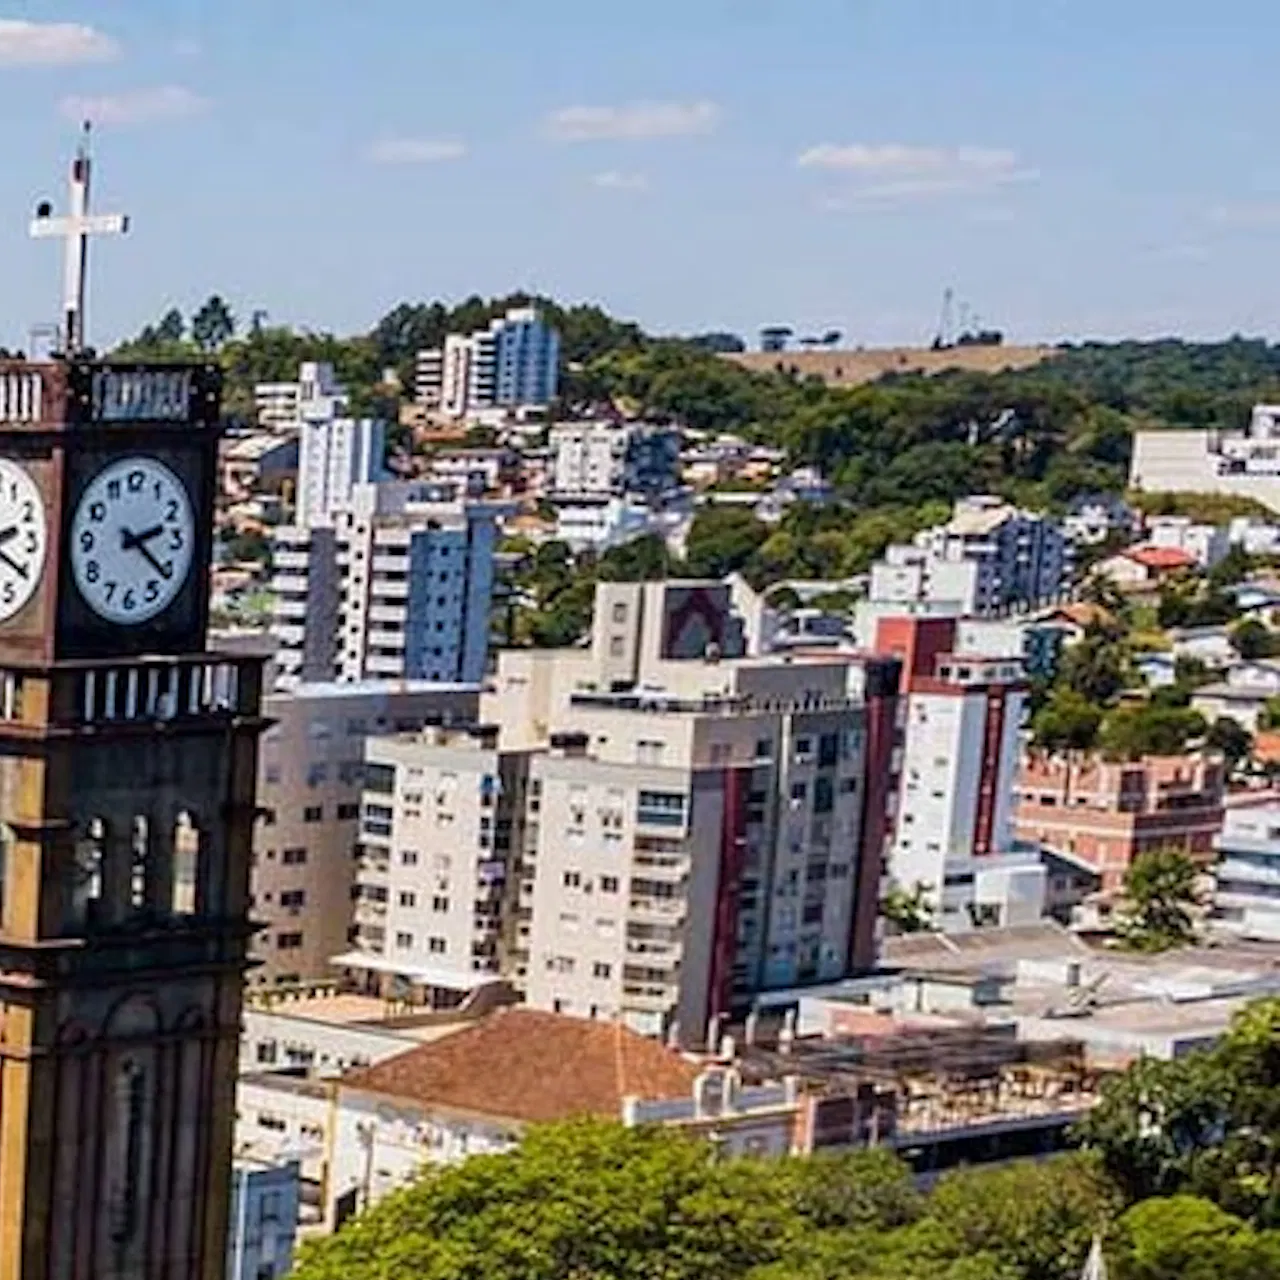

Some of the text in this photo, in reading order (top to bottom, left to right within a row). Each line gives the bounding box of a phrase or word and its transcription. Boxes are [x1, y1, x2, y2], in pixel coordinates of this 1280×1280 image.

[10, 483, 17, 500] 1
[154, 482, 162, 500] 1
[24, 501, 33, 522] 2
[165, 500, 179, 522] 2
[27, 530, 38, 554] 3
[80, 531, 94, 553] 9
[170, 529, 183, 551] 3
[87, 560, 100, 583] 8
[3, 582, 16, 604] 5
[103, 581, 116, 603] 7
[123, 589, 137, 610] 6
[144, 580, 159, 602] 5
